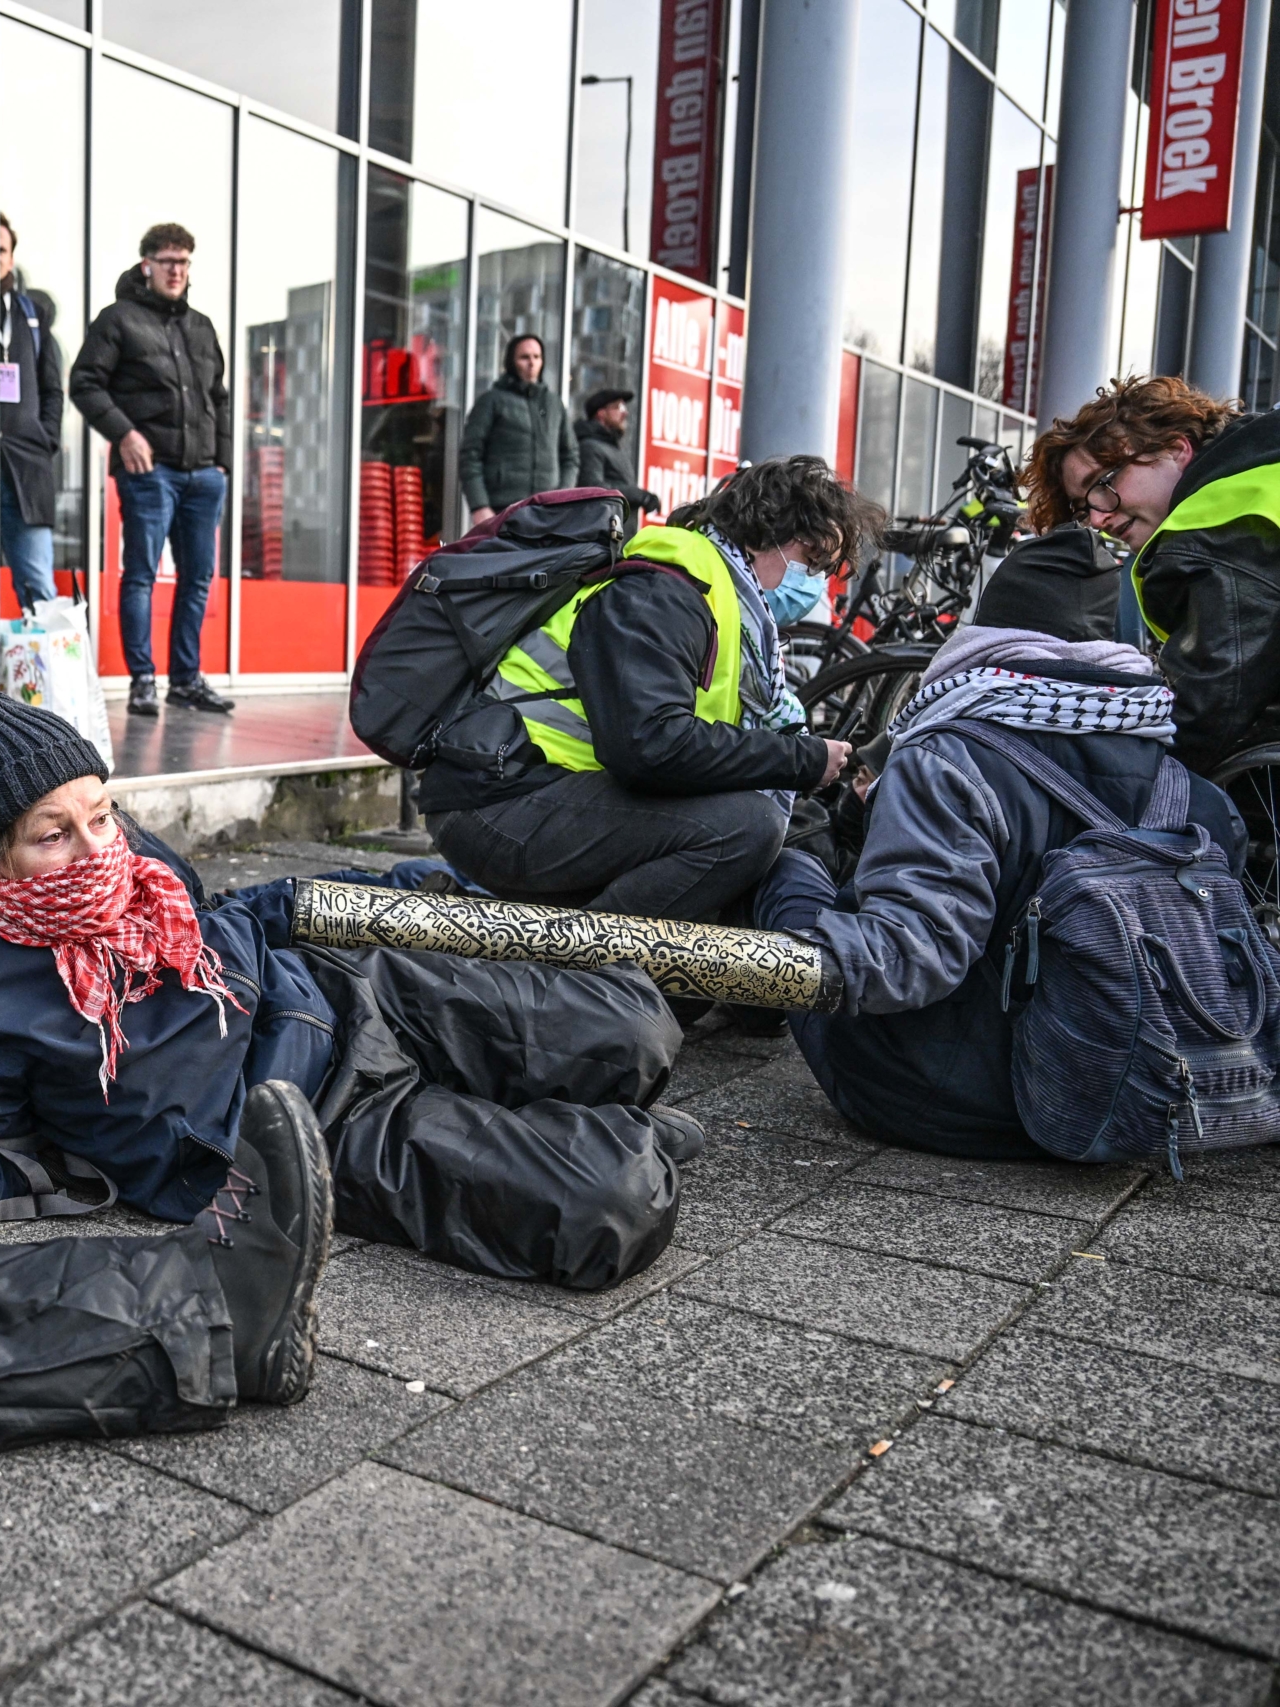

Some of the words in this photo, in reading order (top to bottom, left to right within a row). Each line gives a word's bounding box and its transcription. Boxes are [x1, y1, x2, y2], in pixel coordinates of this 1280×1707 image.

[1161, 53, 1227, 200] Broek
[652, 296, 701, 367] Alle
[650, 387, 704, 448] voor
[319, 890, 348, 912] NO
[690, 954, 727, 978] FOOD
[721, 932, 807, 984] FRIENDS
